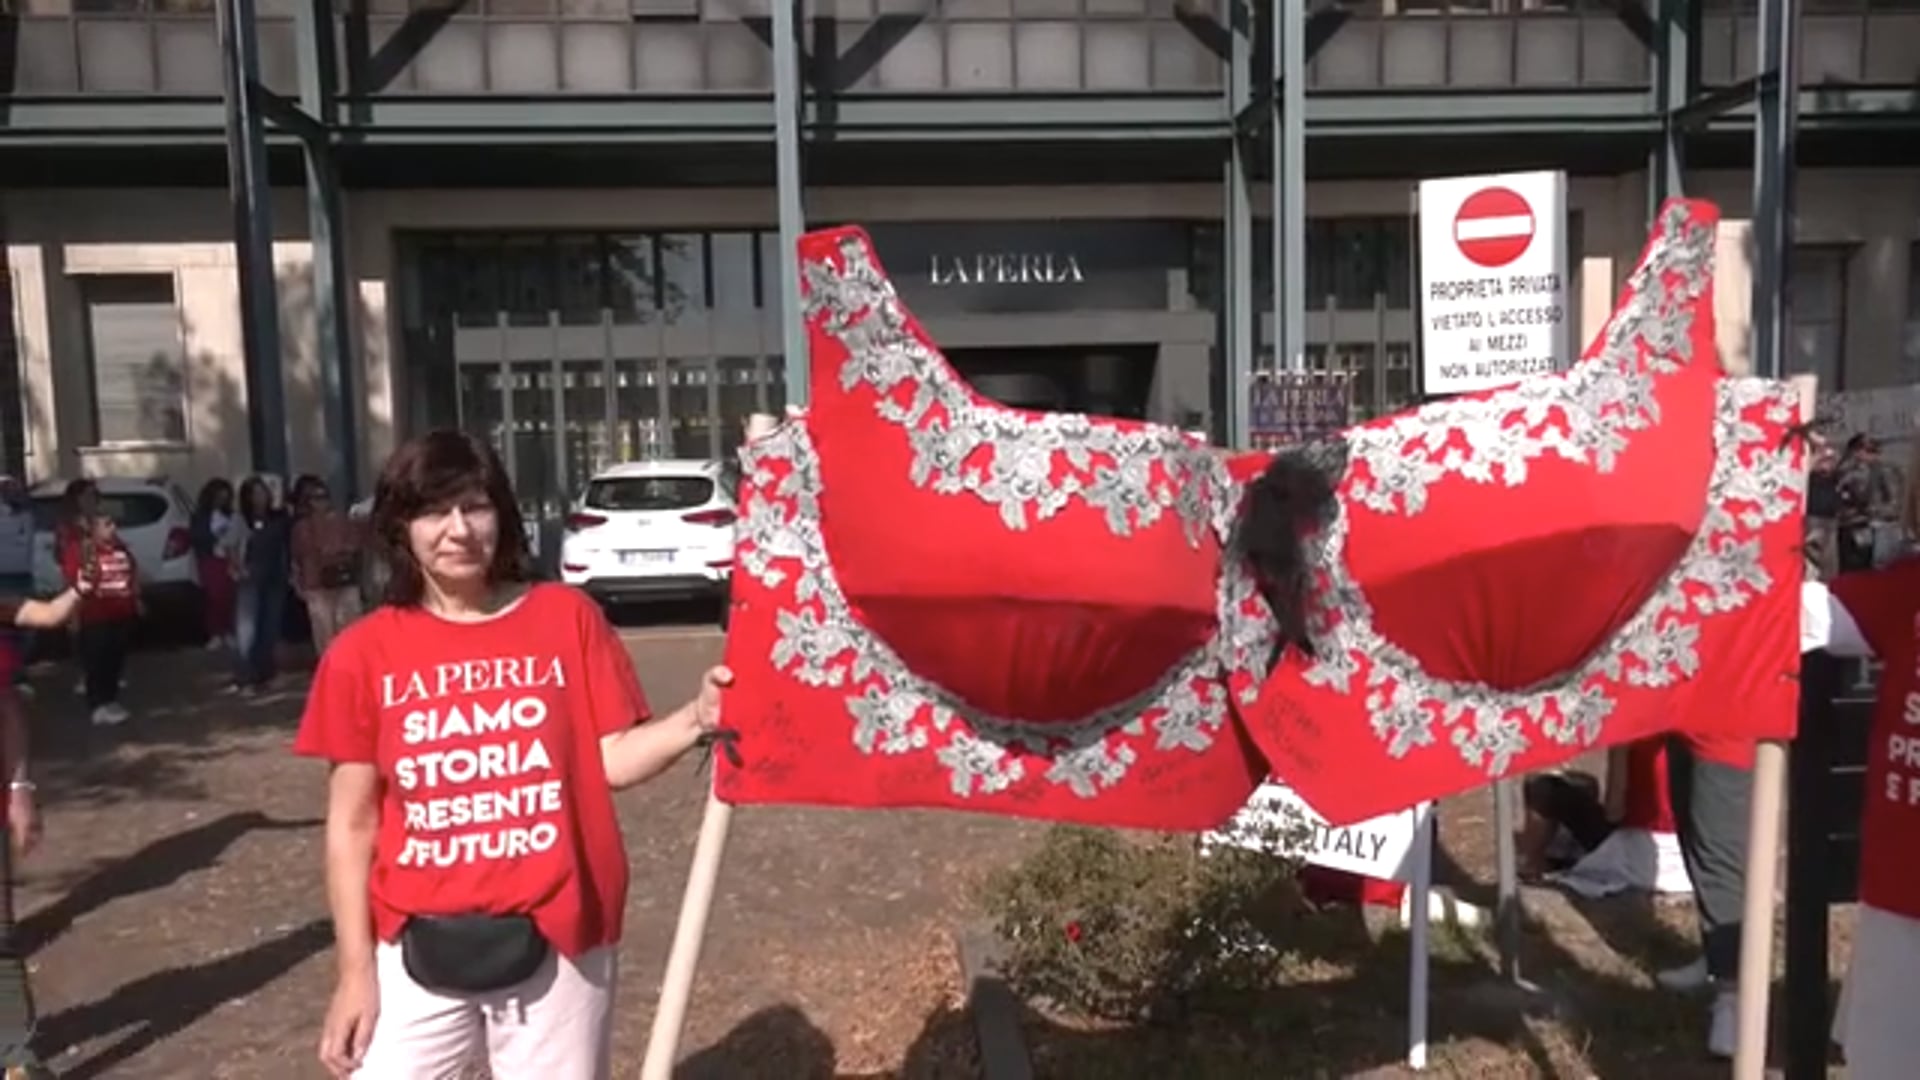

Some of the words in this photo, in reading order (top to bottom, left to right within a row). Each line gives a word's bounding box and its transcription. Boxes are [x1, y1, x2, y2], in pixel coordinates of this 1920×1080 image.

[930, 254, 969, 284] LA
[975, 253, 1085, 284] PERLA
[1508, 272, 1562, 295] PRIVATA
[1431, 310, 1484, 331] VIETATO
[1486, 332, 1529, 352] MEZZI
[1439, 361, 1469, 379] NON
[382, 670, 430, 708] LA
[434, 655, 566, 697] PERLA
[402, 696, 547, 744] SIAMO
[395, 737, 551, 791] STORIA
[1309, 817, 1387, 862] ITALY
